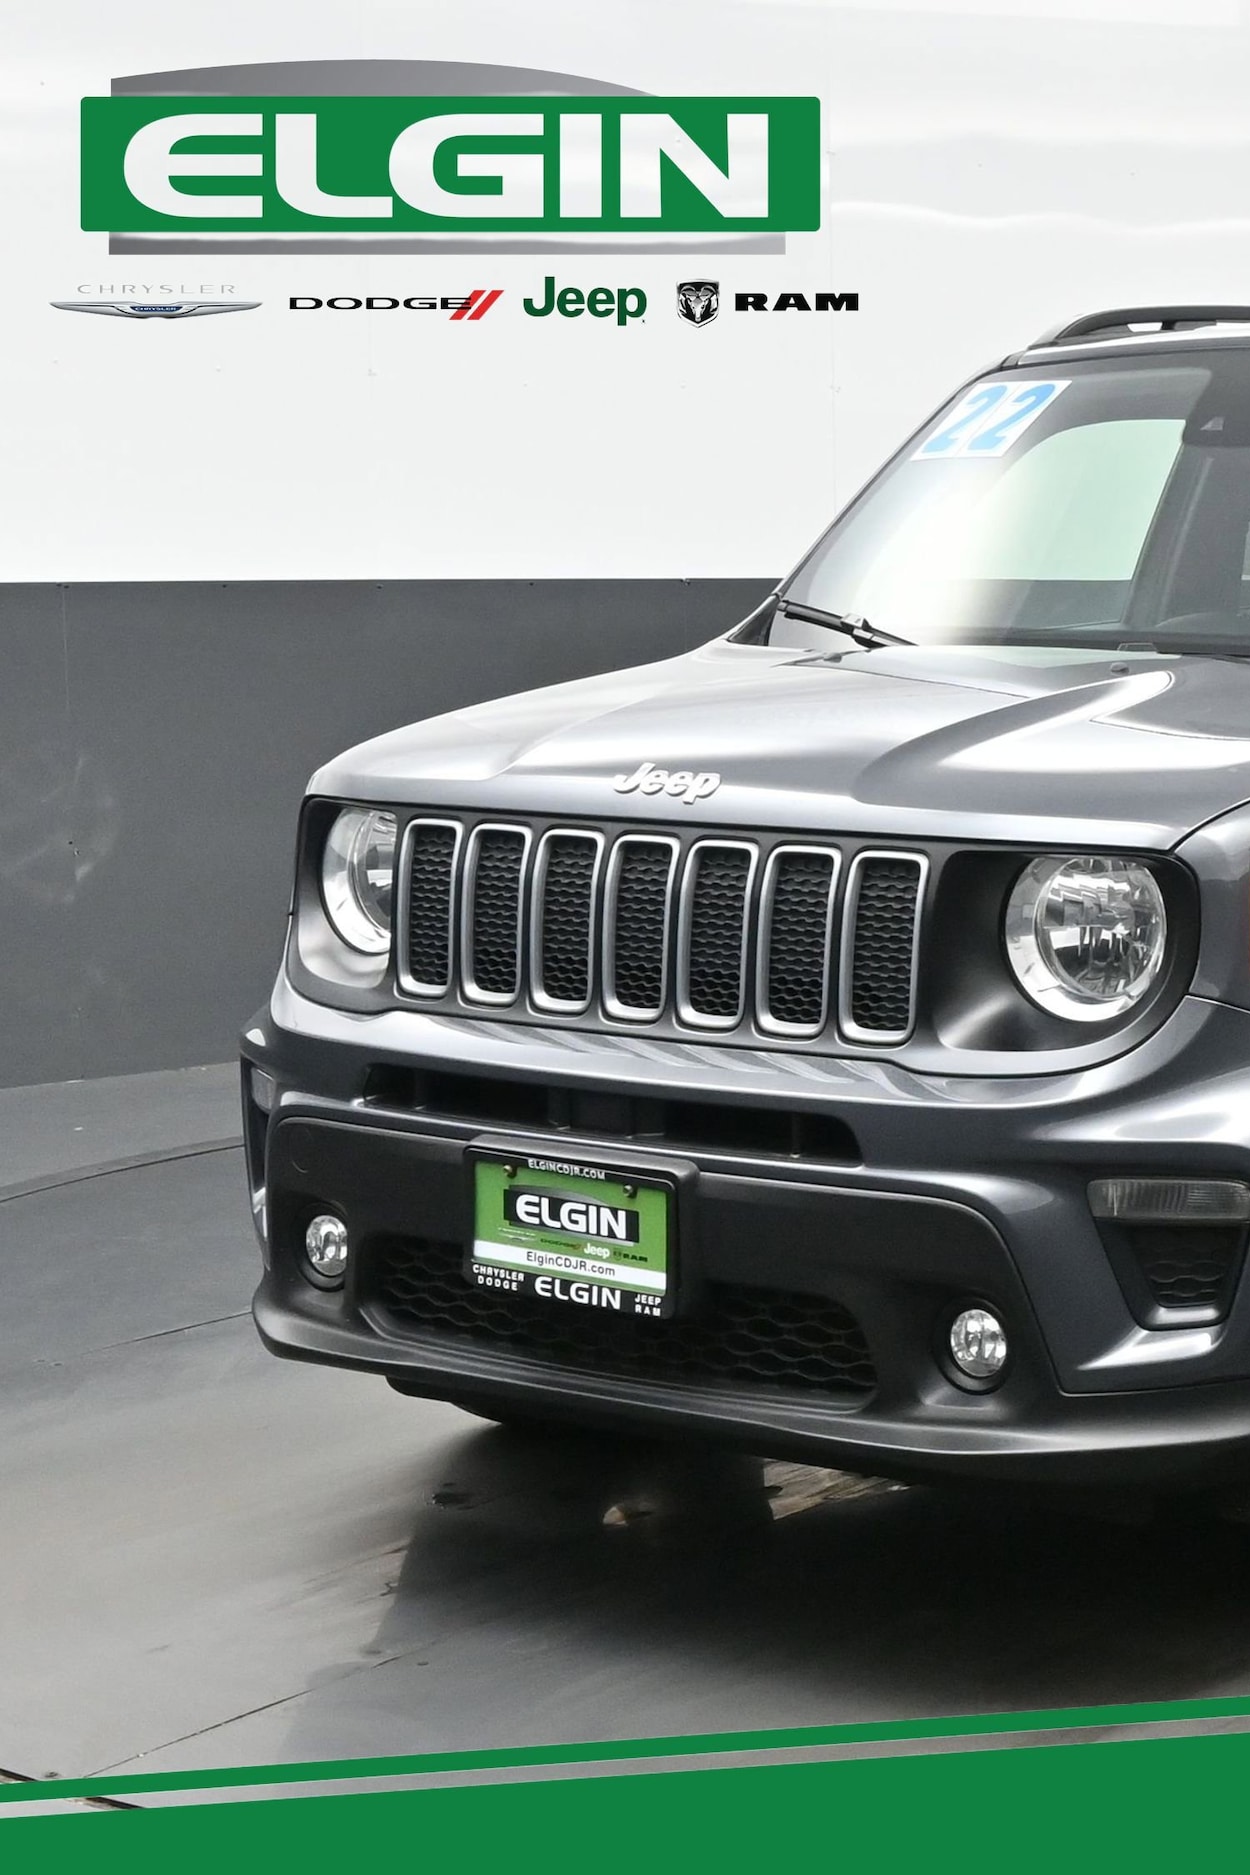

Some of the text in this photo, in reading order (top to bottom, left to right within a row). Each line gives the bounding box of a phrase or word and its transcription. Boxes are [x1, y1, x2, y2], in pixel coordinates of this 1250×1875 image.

[922, 384, 1056, 454] 22
[613, 762, 721, 805] Jeep
[527, 1159, 606, 1180] ELGINCDJR.COM
[515, 1194, 627, 1239] ELGIN
[583, 1242, 610, 1259] Jeep
[472, 1264, 525, 1282] CHRYSLER
[526, 1251, 616, 1277] ElginCDJR.com
[477, 1276, 518, 1291] DODGE
[534, 1276, 622, 1310] ELGIN
[634, 1294, 662, 1306] JEEP
[635, 1305, 661, 1317] RAM
